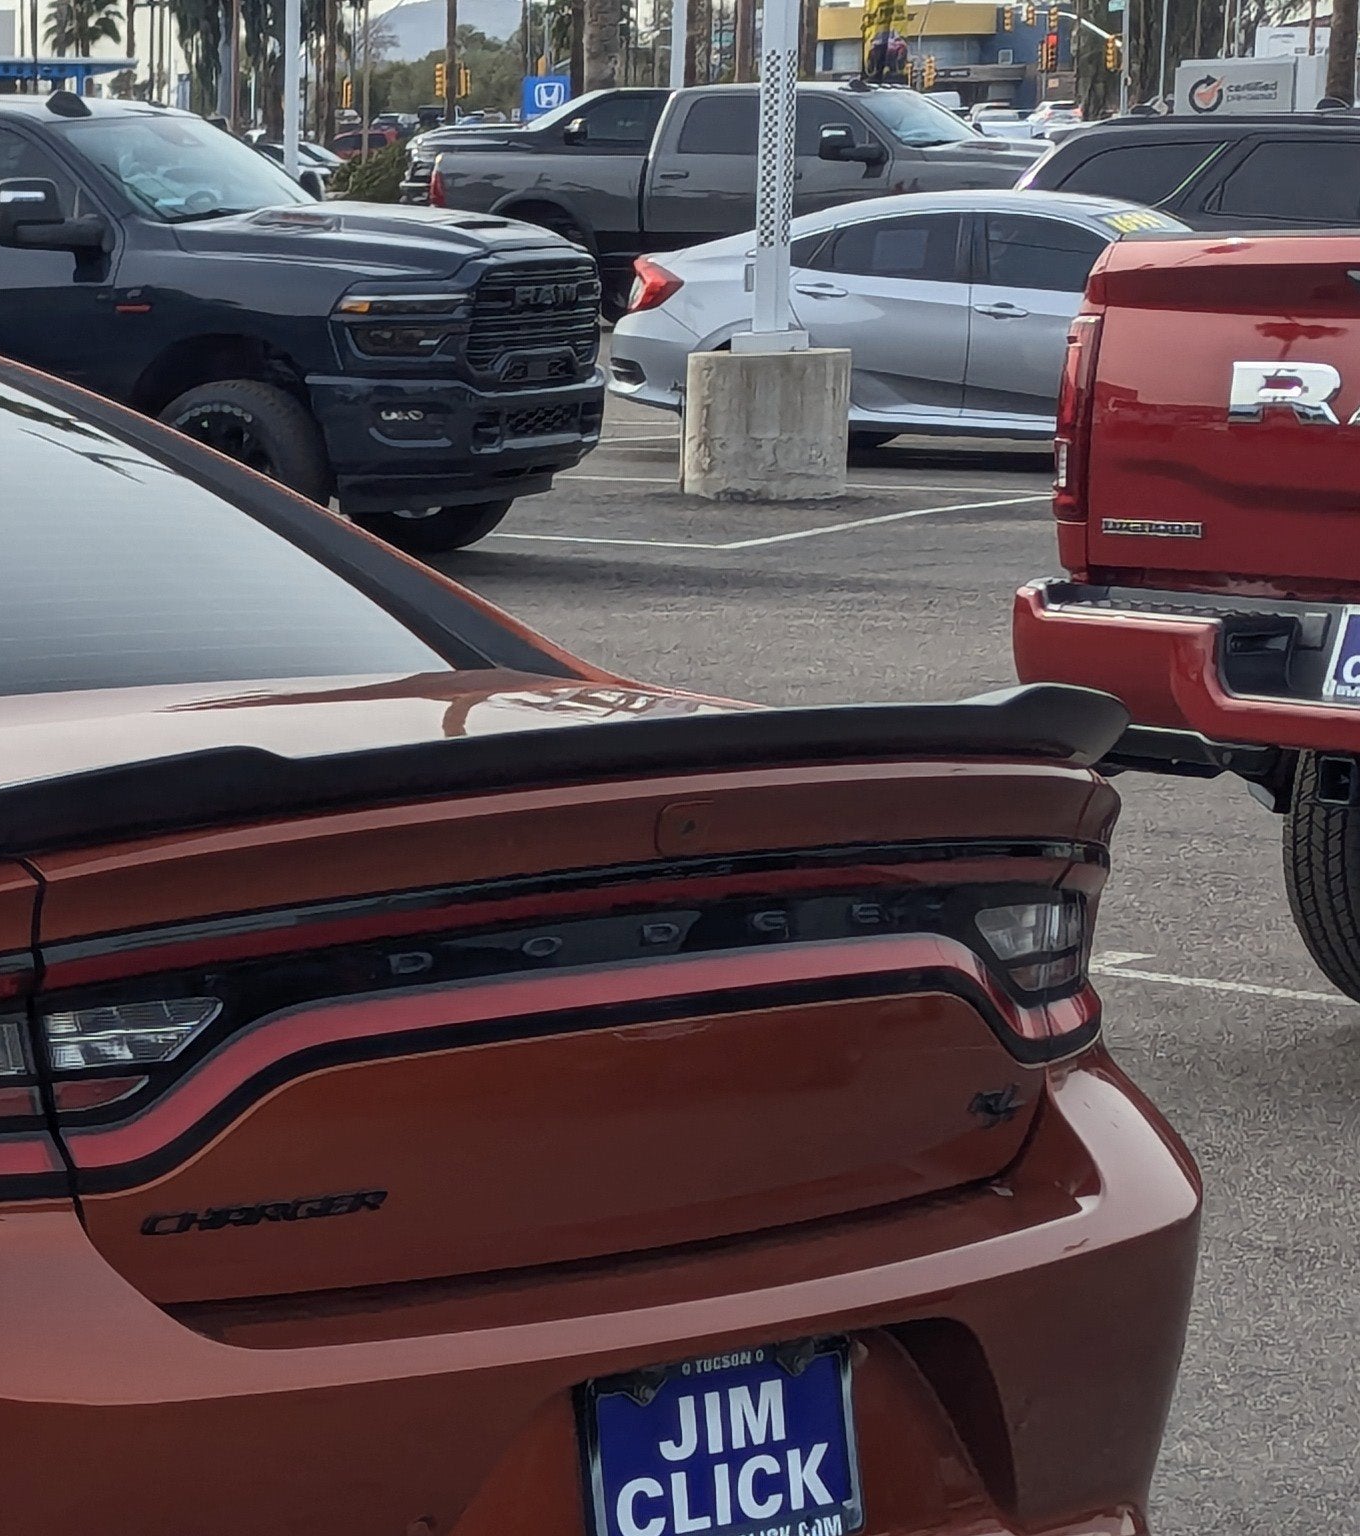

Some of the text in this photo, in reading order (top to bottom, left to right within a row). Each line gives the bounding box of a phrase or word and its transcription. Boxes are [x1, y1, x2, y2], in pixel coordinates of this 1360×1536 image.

[1228, 361, 1360, 425] R
[389, 902, 882, 975] DODGE
[140, 1189, 388, 1236] CHARGER
[659, 1379, 786, 1462] JIM
